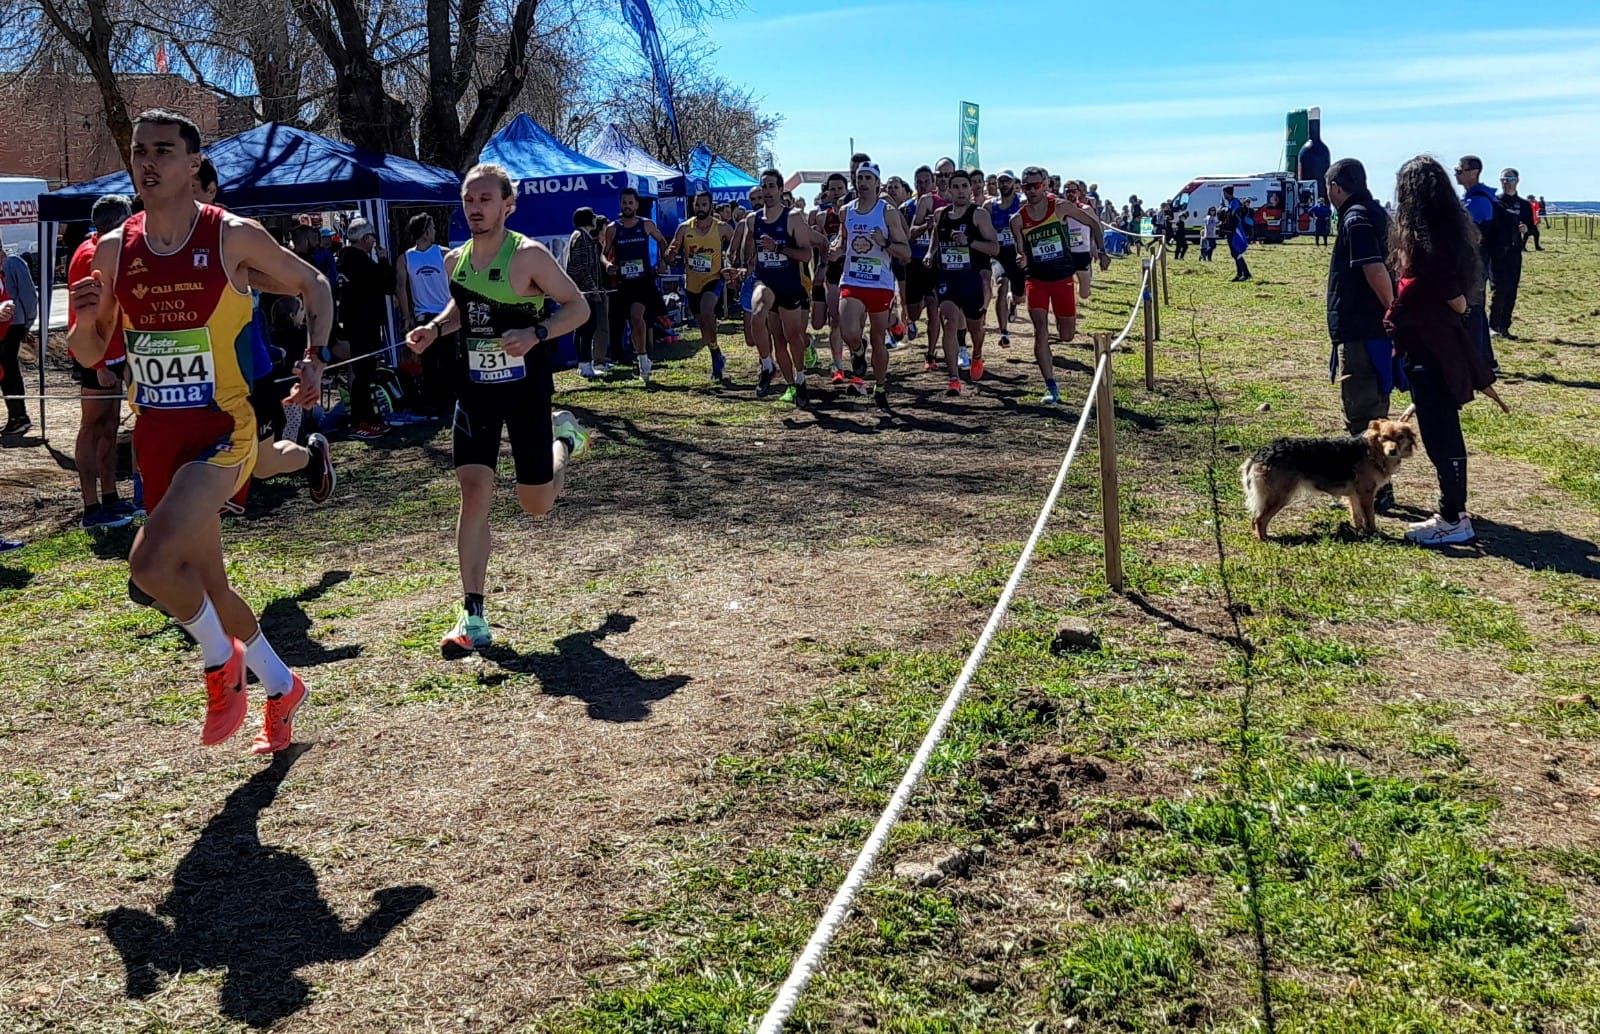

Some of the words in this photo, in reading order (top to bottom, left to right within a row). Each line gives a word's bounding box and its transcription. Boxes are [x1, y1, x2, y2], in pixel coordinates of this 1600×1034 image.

[524, 176, 588, 195] RIOJA
[712, 191, 749, 202] MATA
[1039, 244, 1056, 254] 108
[763, 252, 780, 261] 343
[946, 255, 963, 263] 278
[857, 264, 874, 274] 322
[174, 282, 205, 292] RURAL
[151, 299, 185, 312] VINO
[140, 315, 157, 325] DE
[160, 311, 198, 323] TORO
[478, 351, 507, 369] 231
[134, 354, 208, 385] 1044
